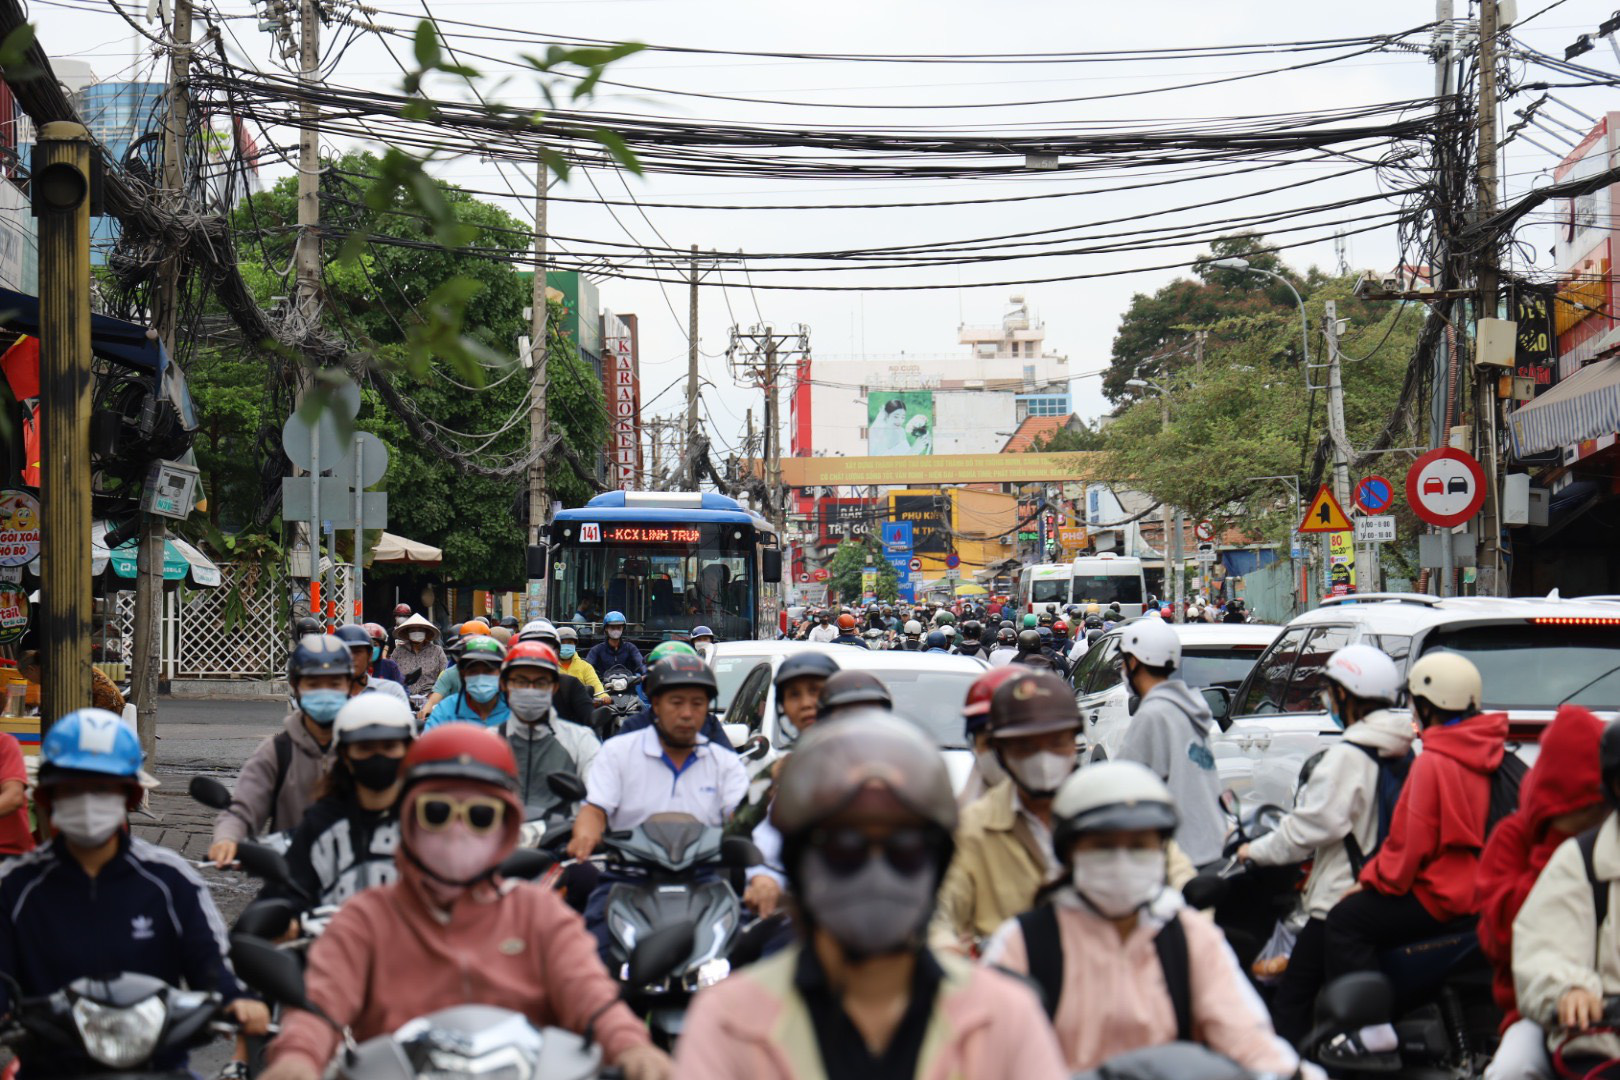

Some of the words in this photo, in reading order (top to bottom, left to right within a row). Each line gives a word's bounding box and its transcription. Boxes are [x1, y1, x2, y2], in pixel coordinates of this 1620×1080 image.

[618, 340, 632, 448] KARAOKE
[582, 526, 598, 540] 141
[616, 529, 639, 540] KCX
[642, 530, 668, 540] LINH
